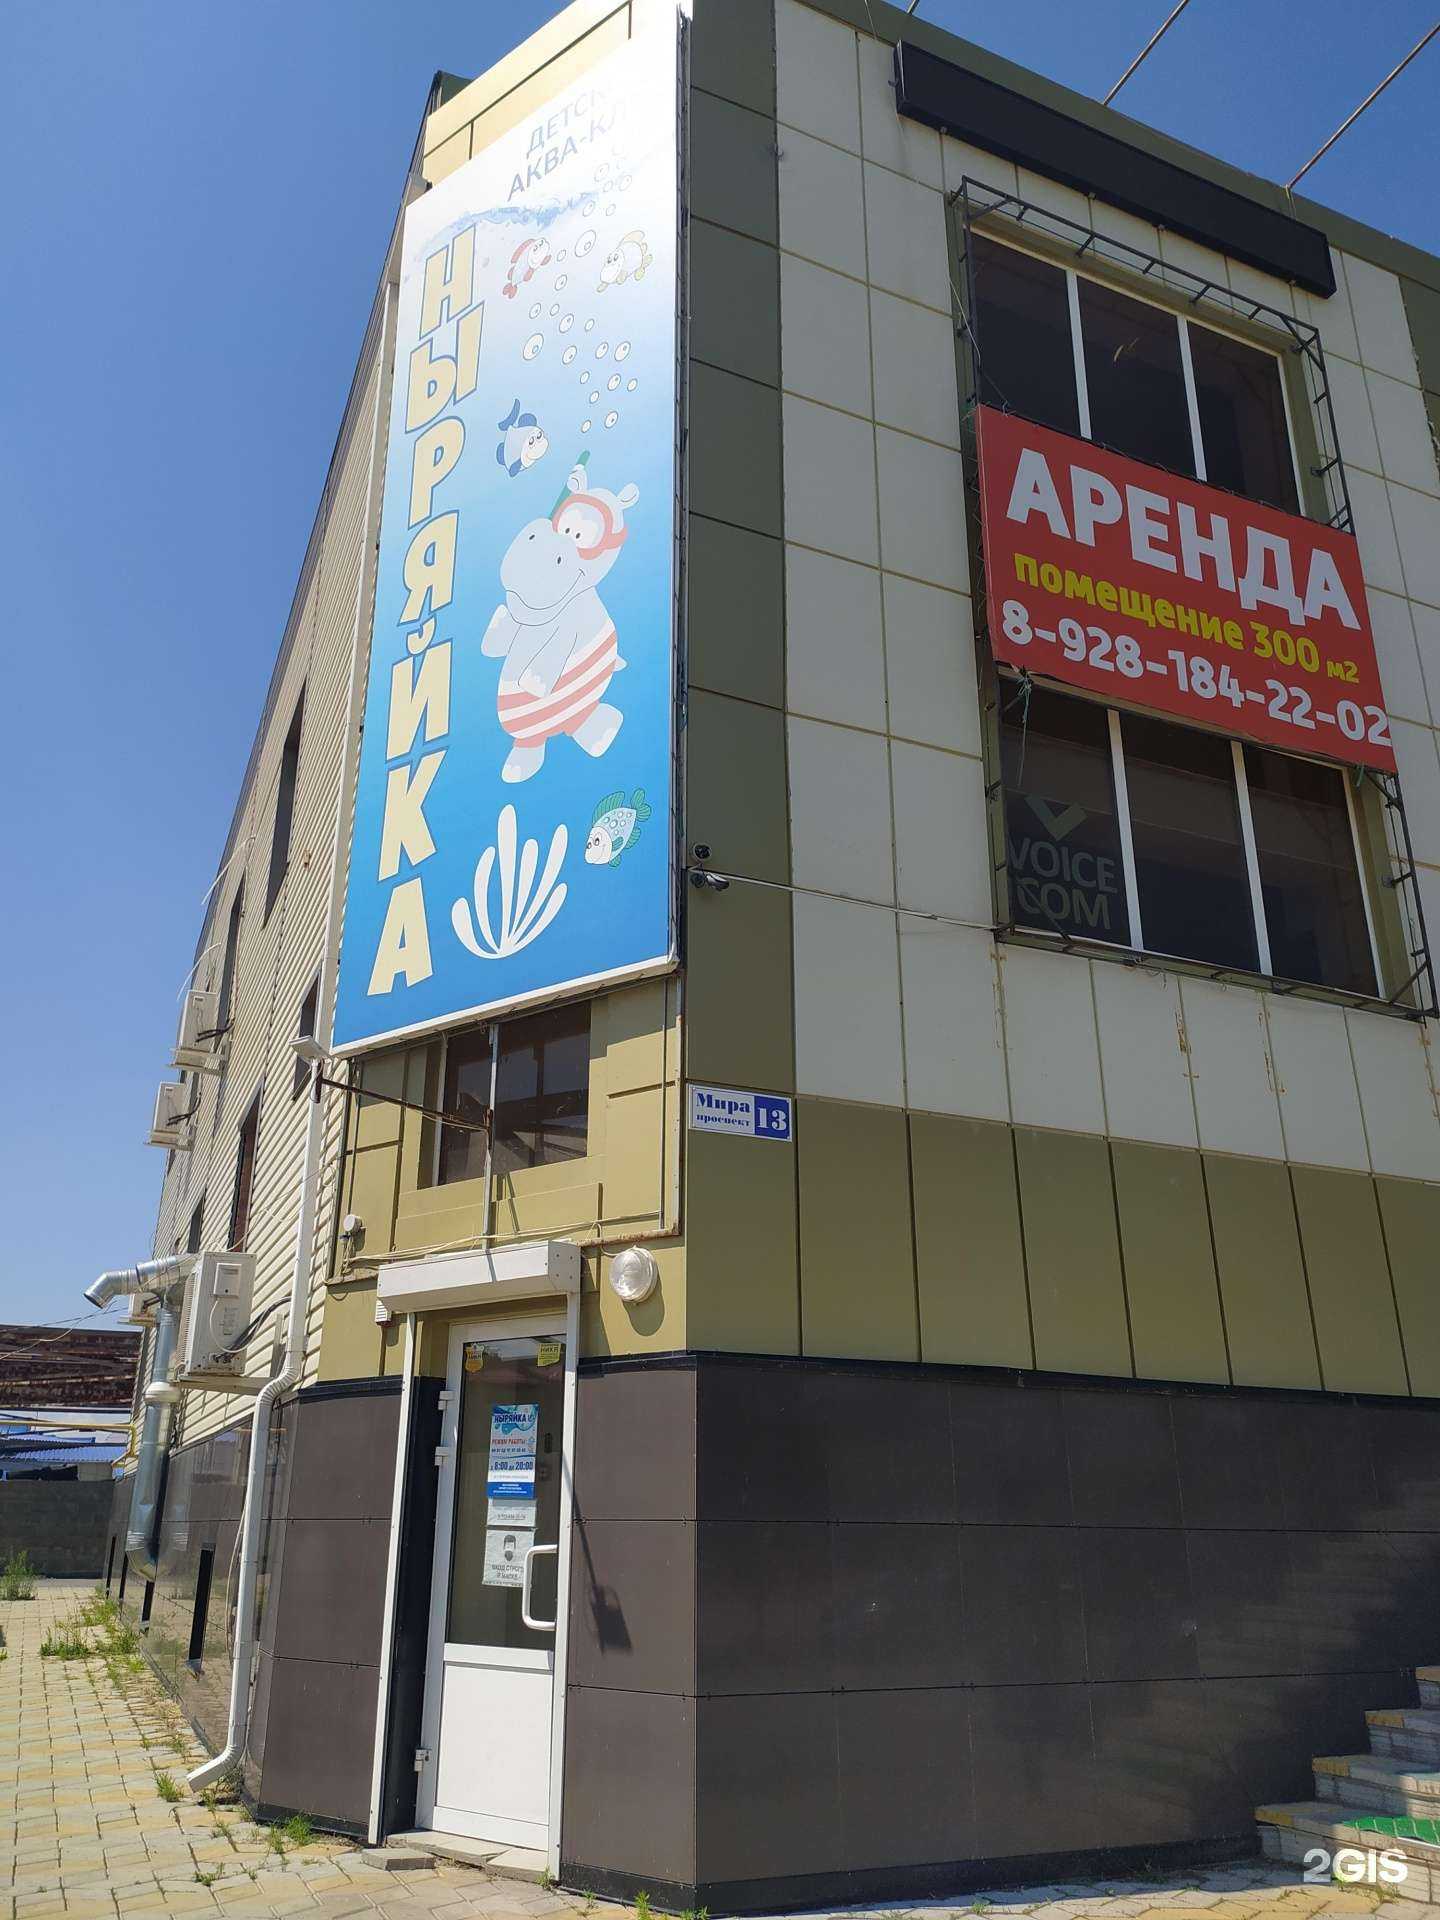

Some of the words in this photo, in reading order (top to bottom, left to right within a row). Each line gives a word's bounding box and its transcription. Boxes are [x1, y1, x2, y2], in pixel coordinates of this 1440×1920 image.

[1006, 447, 1361, 631] АРЕНДА
[366, 223, 484, 997] НЫРЯЙКА
[1014, 552, 1244, 651] помещение
[1250, 622, 1320, 673] 300
[1327, 659, 1360, 684] м2
[1002, 599, 1392, 747] 8-928-184-22-02
[1008, 834, 1118, 894] VOICE
[1016, 876, 1111, 930] COM
[696, 1092, 751, 1115] Мира
[696, 1113, 750, 1127] проспект
[757, 1106, 787, 1131] 13
